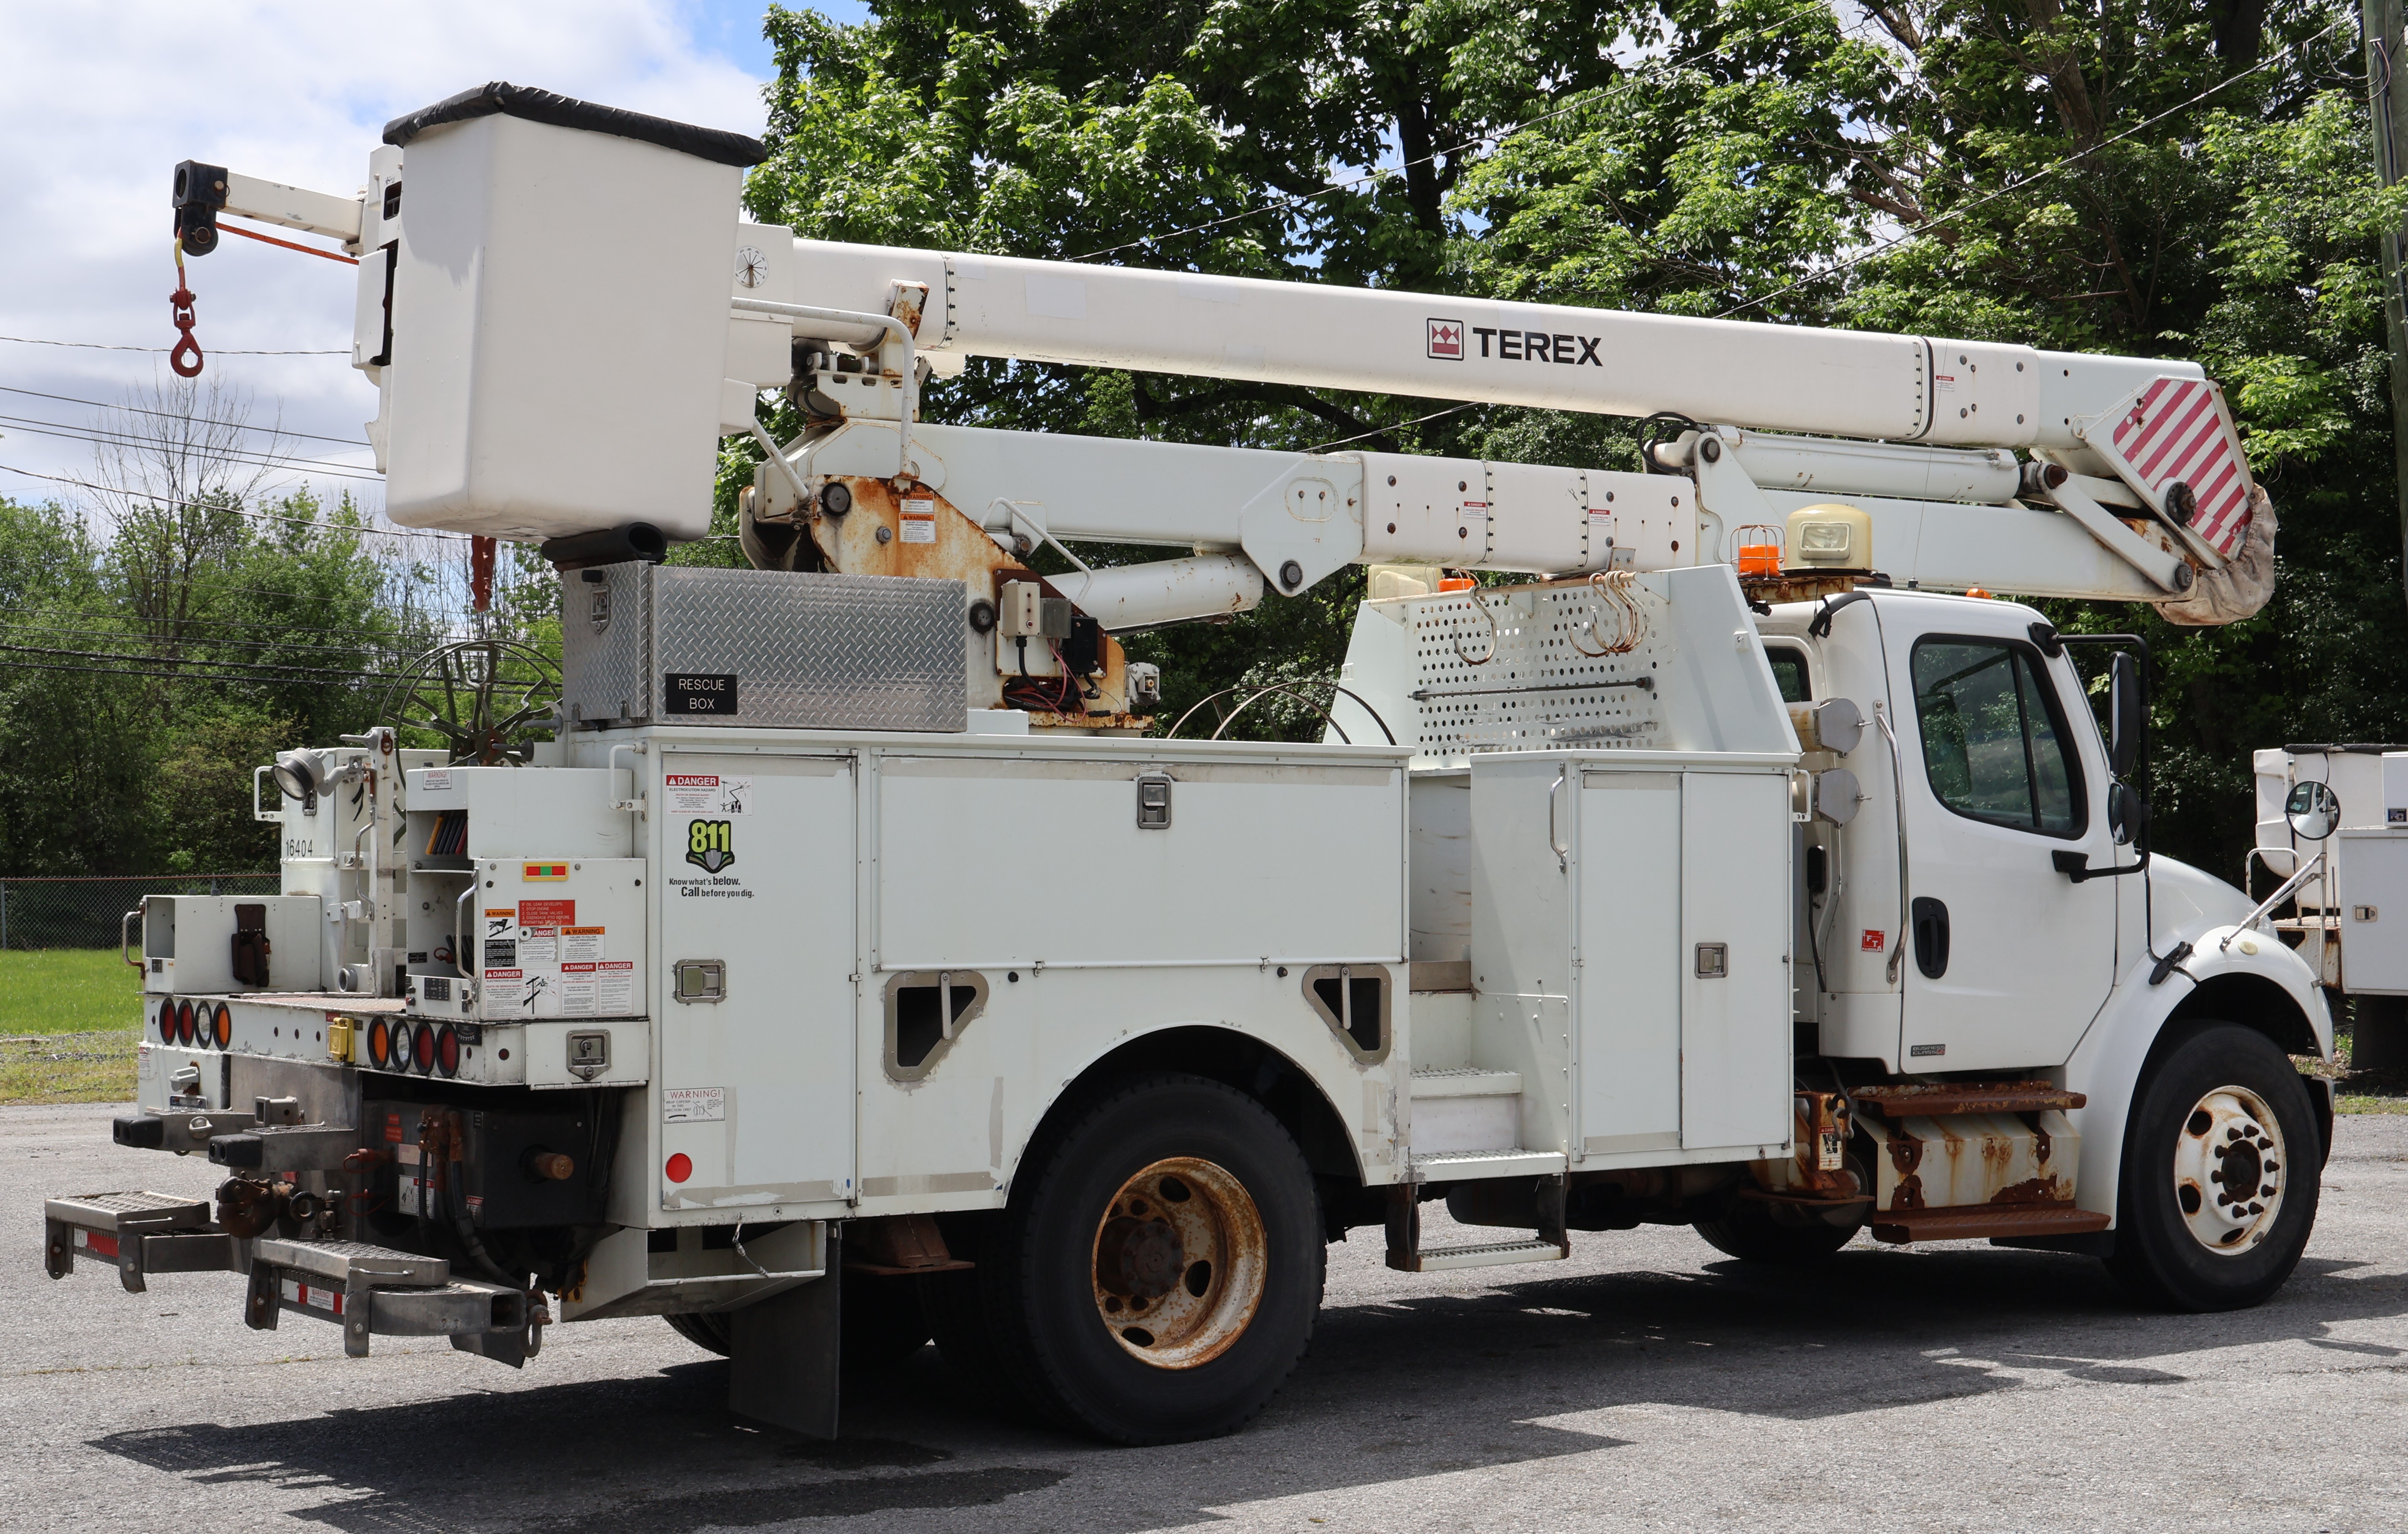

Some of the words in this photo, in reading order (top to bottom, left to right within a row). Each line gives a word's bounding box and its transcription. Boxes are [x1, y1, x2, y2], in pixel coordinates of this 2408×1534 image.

[1473, 327, 1603, 366] TEREX
[679, 679, 725, 690] RESCUE
[690, 698, 714, 709] BOX
[691, 822, 729, 852] 811
[286, 839, 312, 857] 16404
[713, 877, 740, 885] below.
[682, 887, 699, 896] Call
[741, 890, 754, 898] dig.
[670, 1090, 720, 1098] WARNING!
